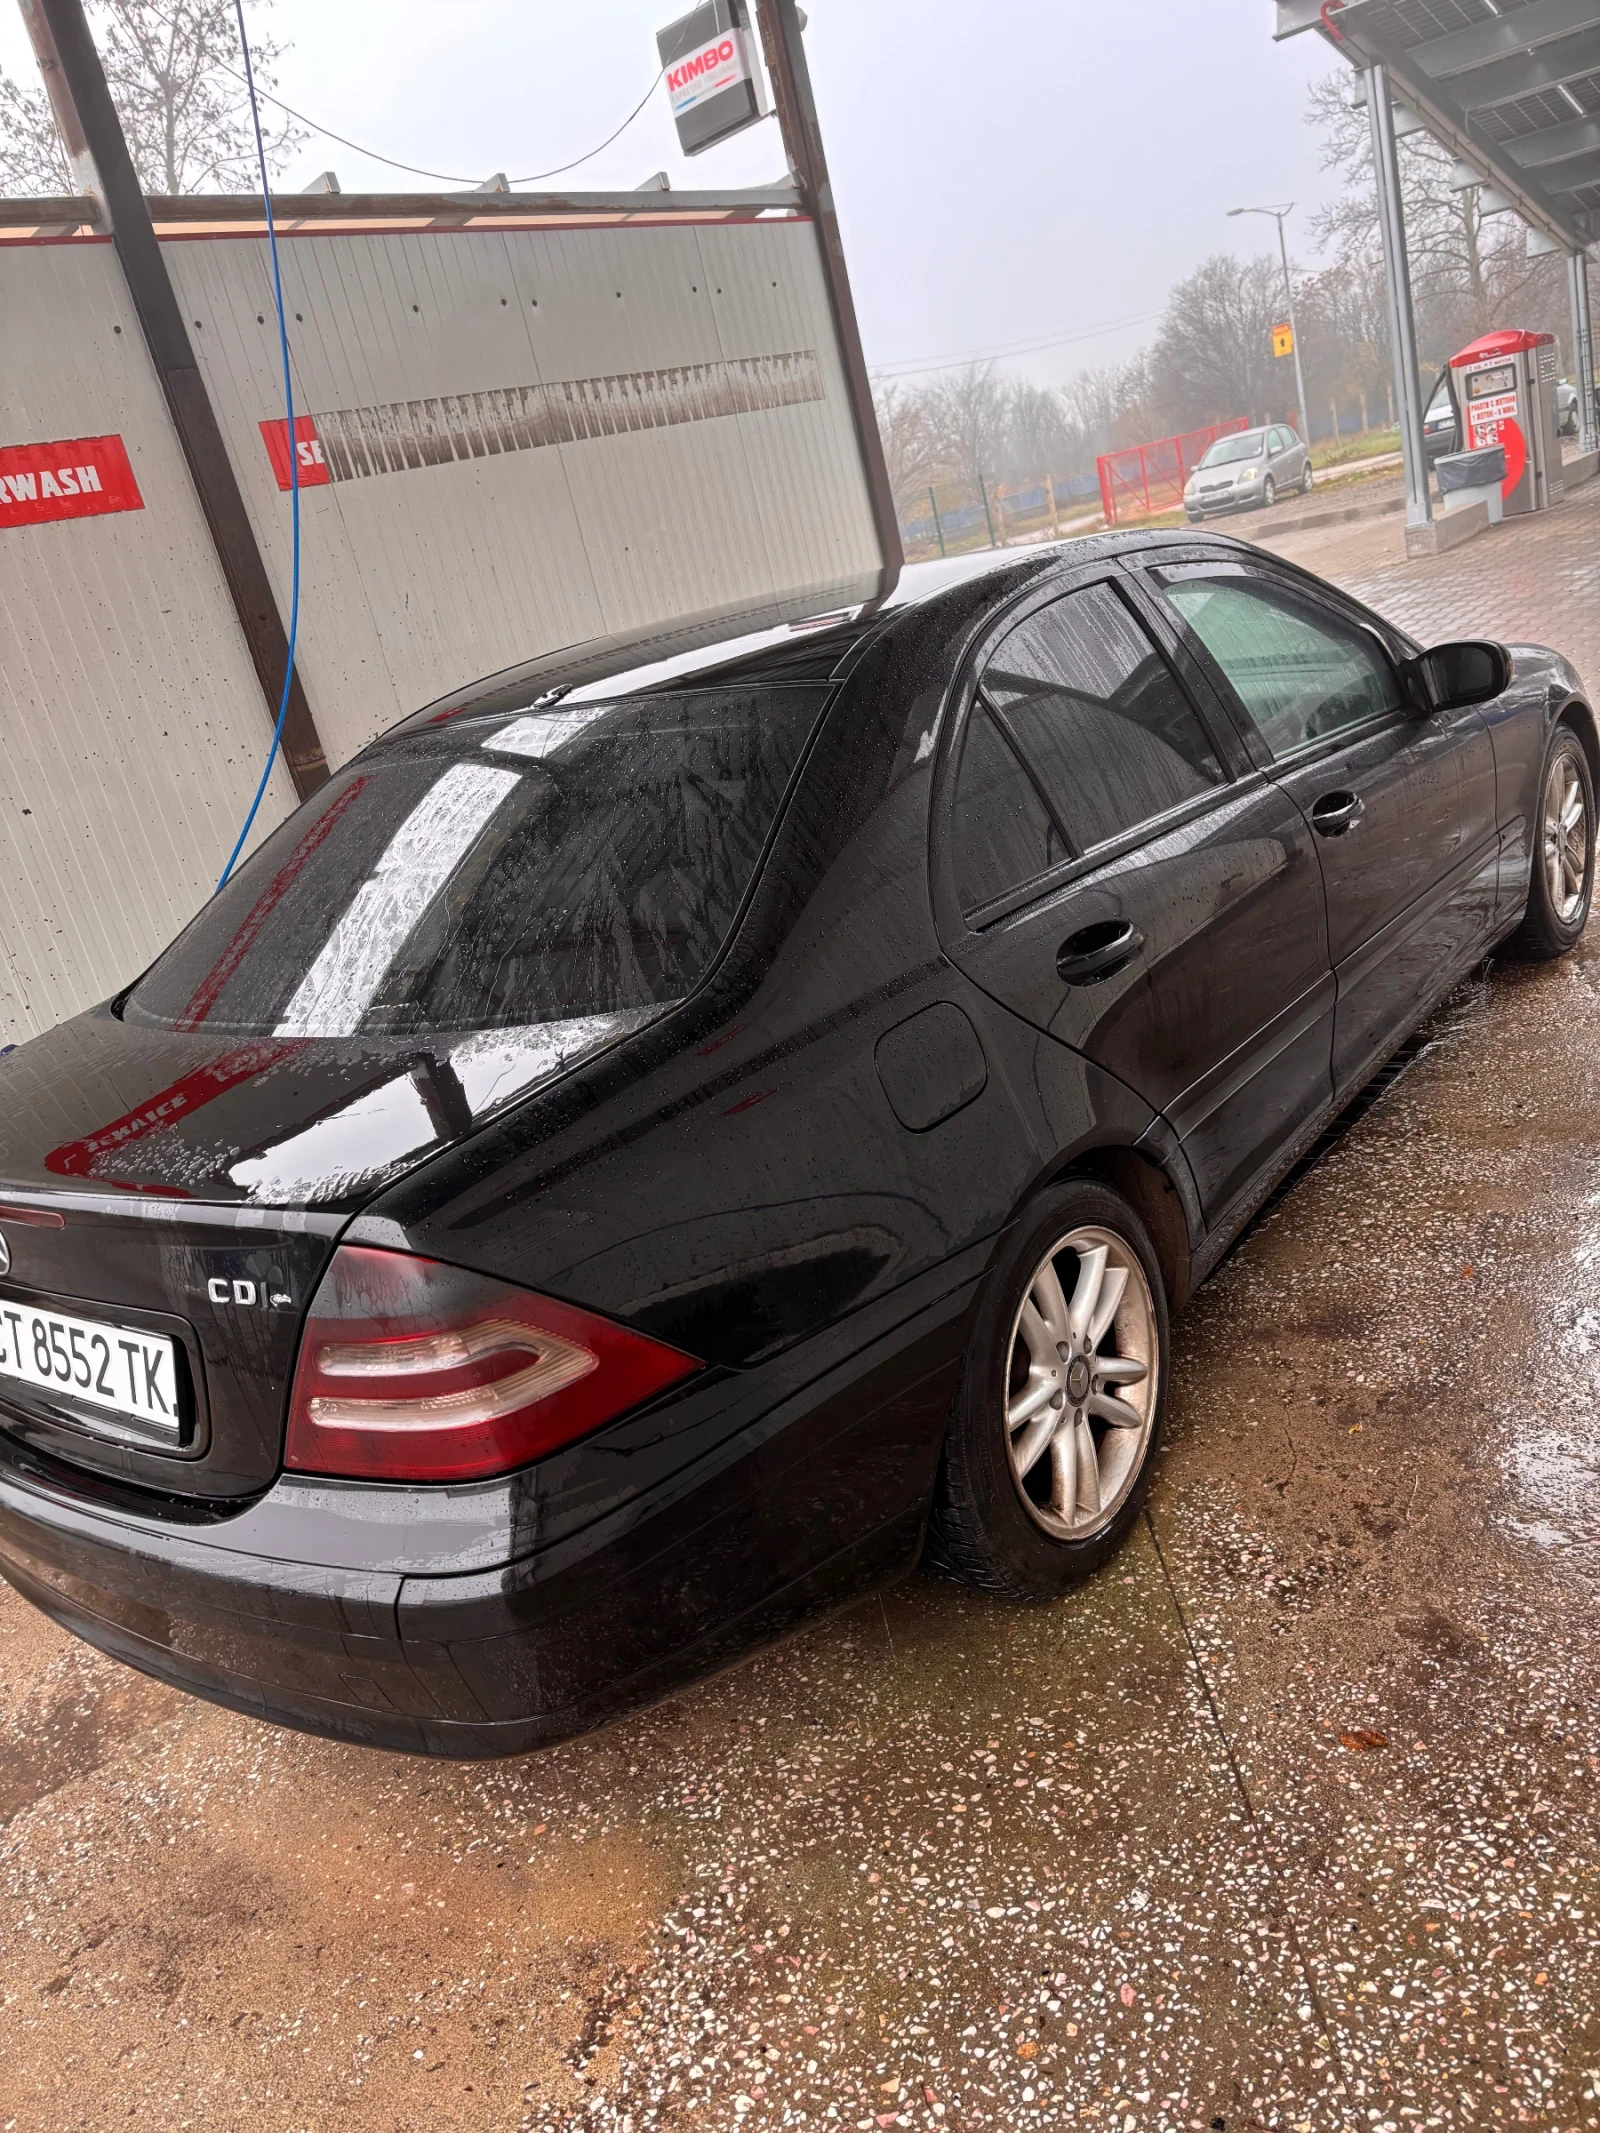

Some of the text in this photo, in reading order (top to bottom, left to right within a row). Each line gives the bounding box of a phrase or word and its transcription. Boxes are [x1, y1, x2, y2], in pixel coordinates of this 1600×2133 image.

[667, 40, 734, 93] KIMBO
[31, 1318, 115, 1397] 8552
[118, 1339, 170, 1416] TK
